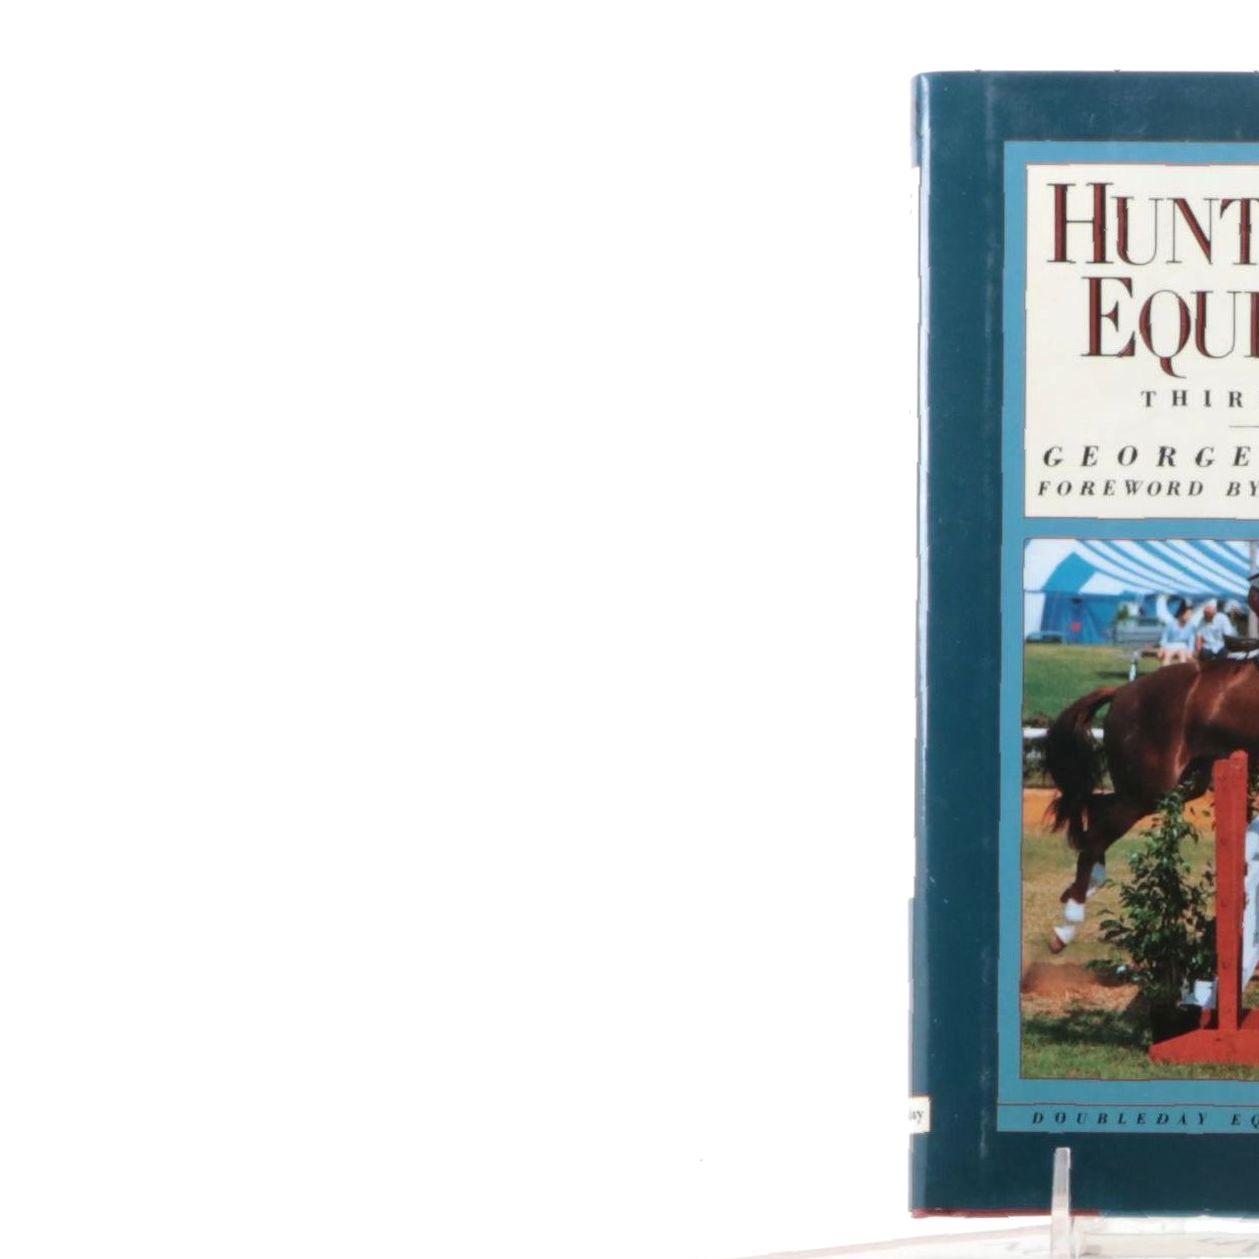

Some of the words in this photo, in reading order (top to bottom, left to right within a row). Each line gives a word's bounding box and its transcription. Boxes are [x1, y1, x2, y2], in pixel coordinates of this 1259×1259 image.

[1043, 446, 1251, 467] GEORGE
[1038, 480, 1205, 498] FOREWORD
[1032, 1111, 1208, 1126] DOUBLEDAY
